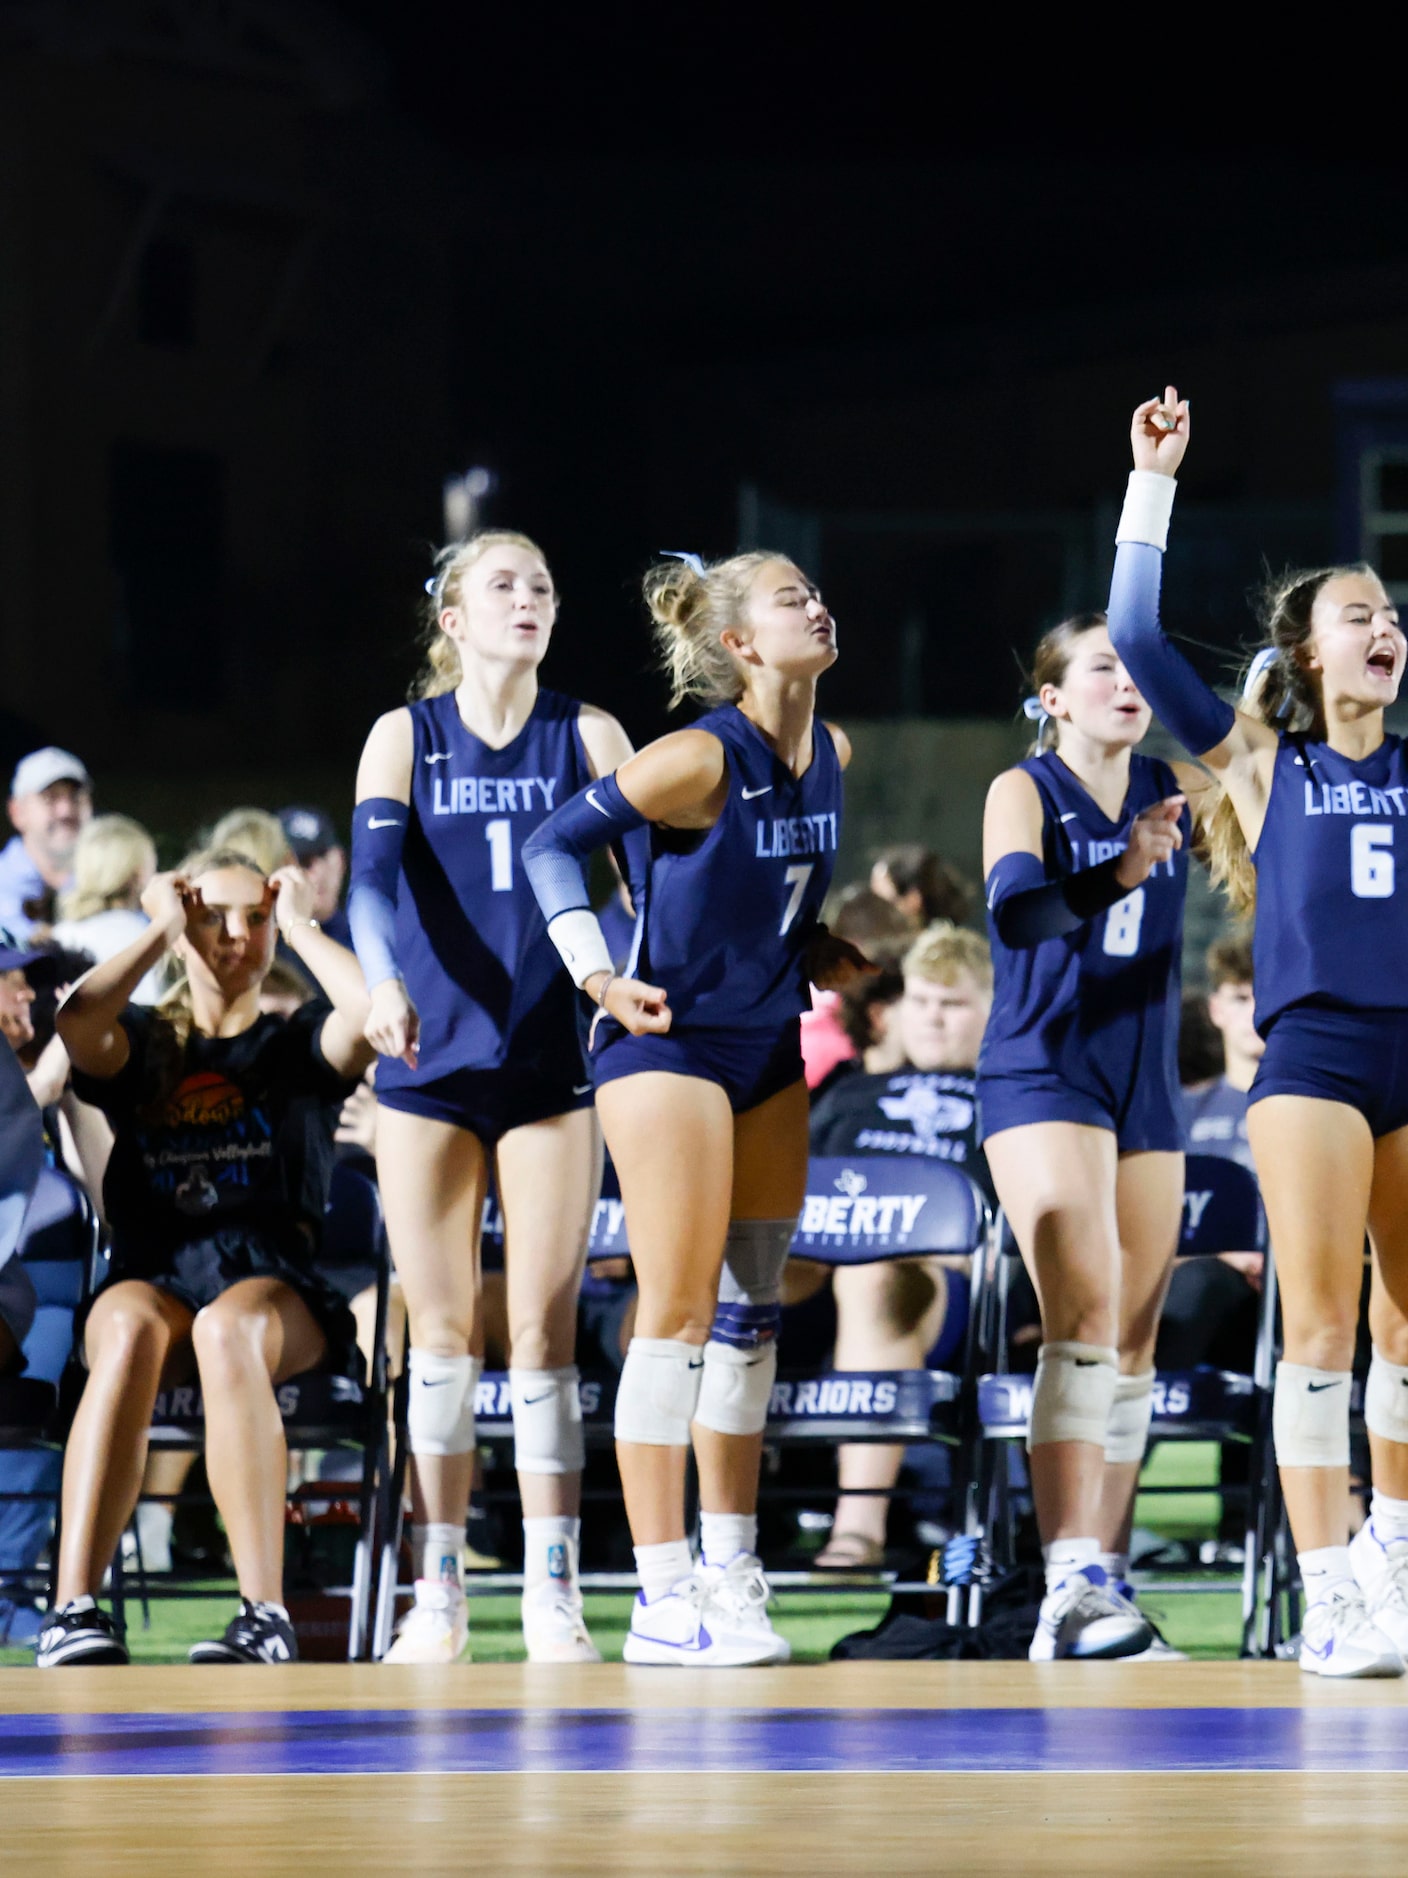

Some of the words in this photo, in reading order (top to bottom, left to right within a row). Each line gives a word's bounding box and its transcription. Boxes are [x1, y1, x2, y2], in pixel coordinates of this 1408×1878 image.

[433, 776, 557, 816] LIBERTY
[485, 818, 513, 892] 1
[1351, 823, 1395, 898] 6
[779, 863, 815, 937] 7
[1103, 886, 1145, 957] 8
[800, 1194, 928, 1235] BERTY
[771, 1380, 898, 1414] RRIORS
